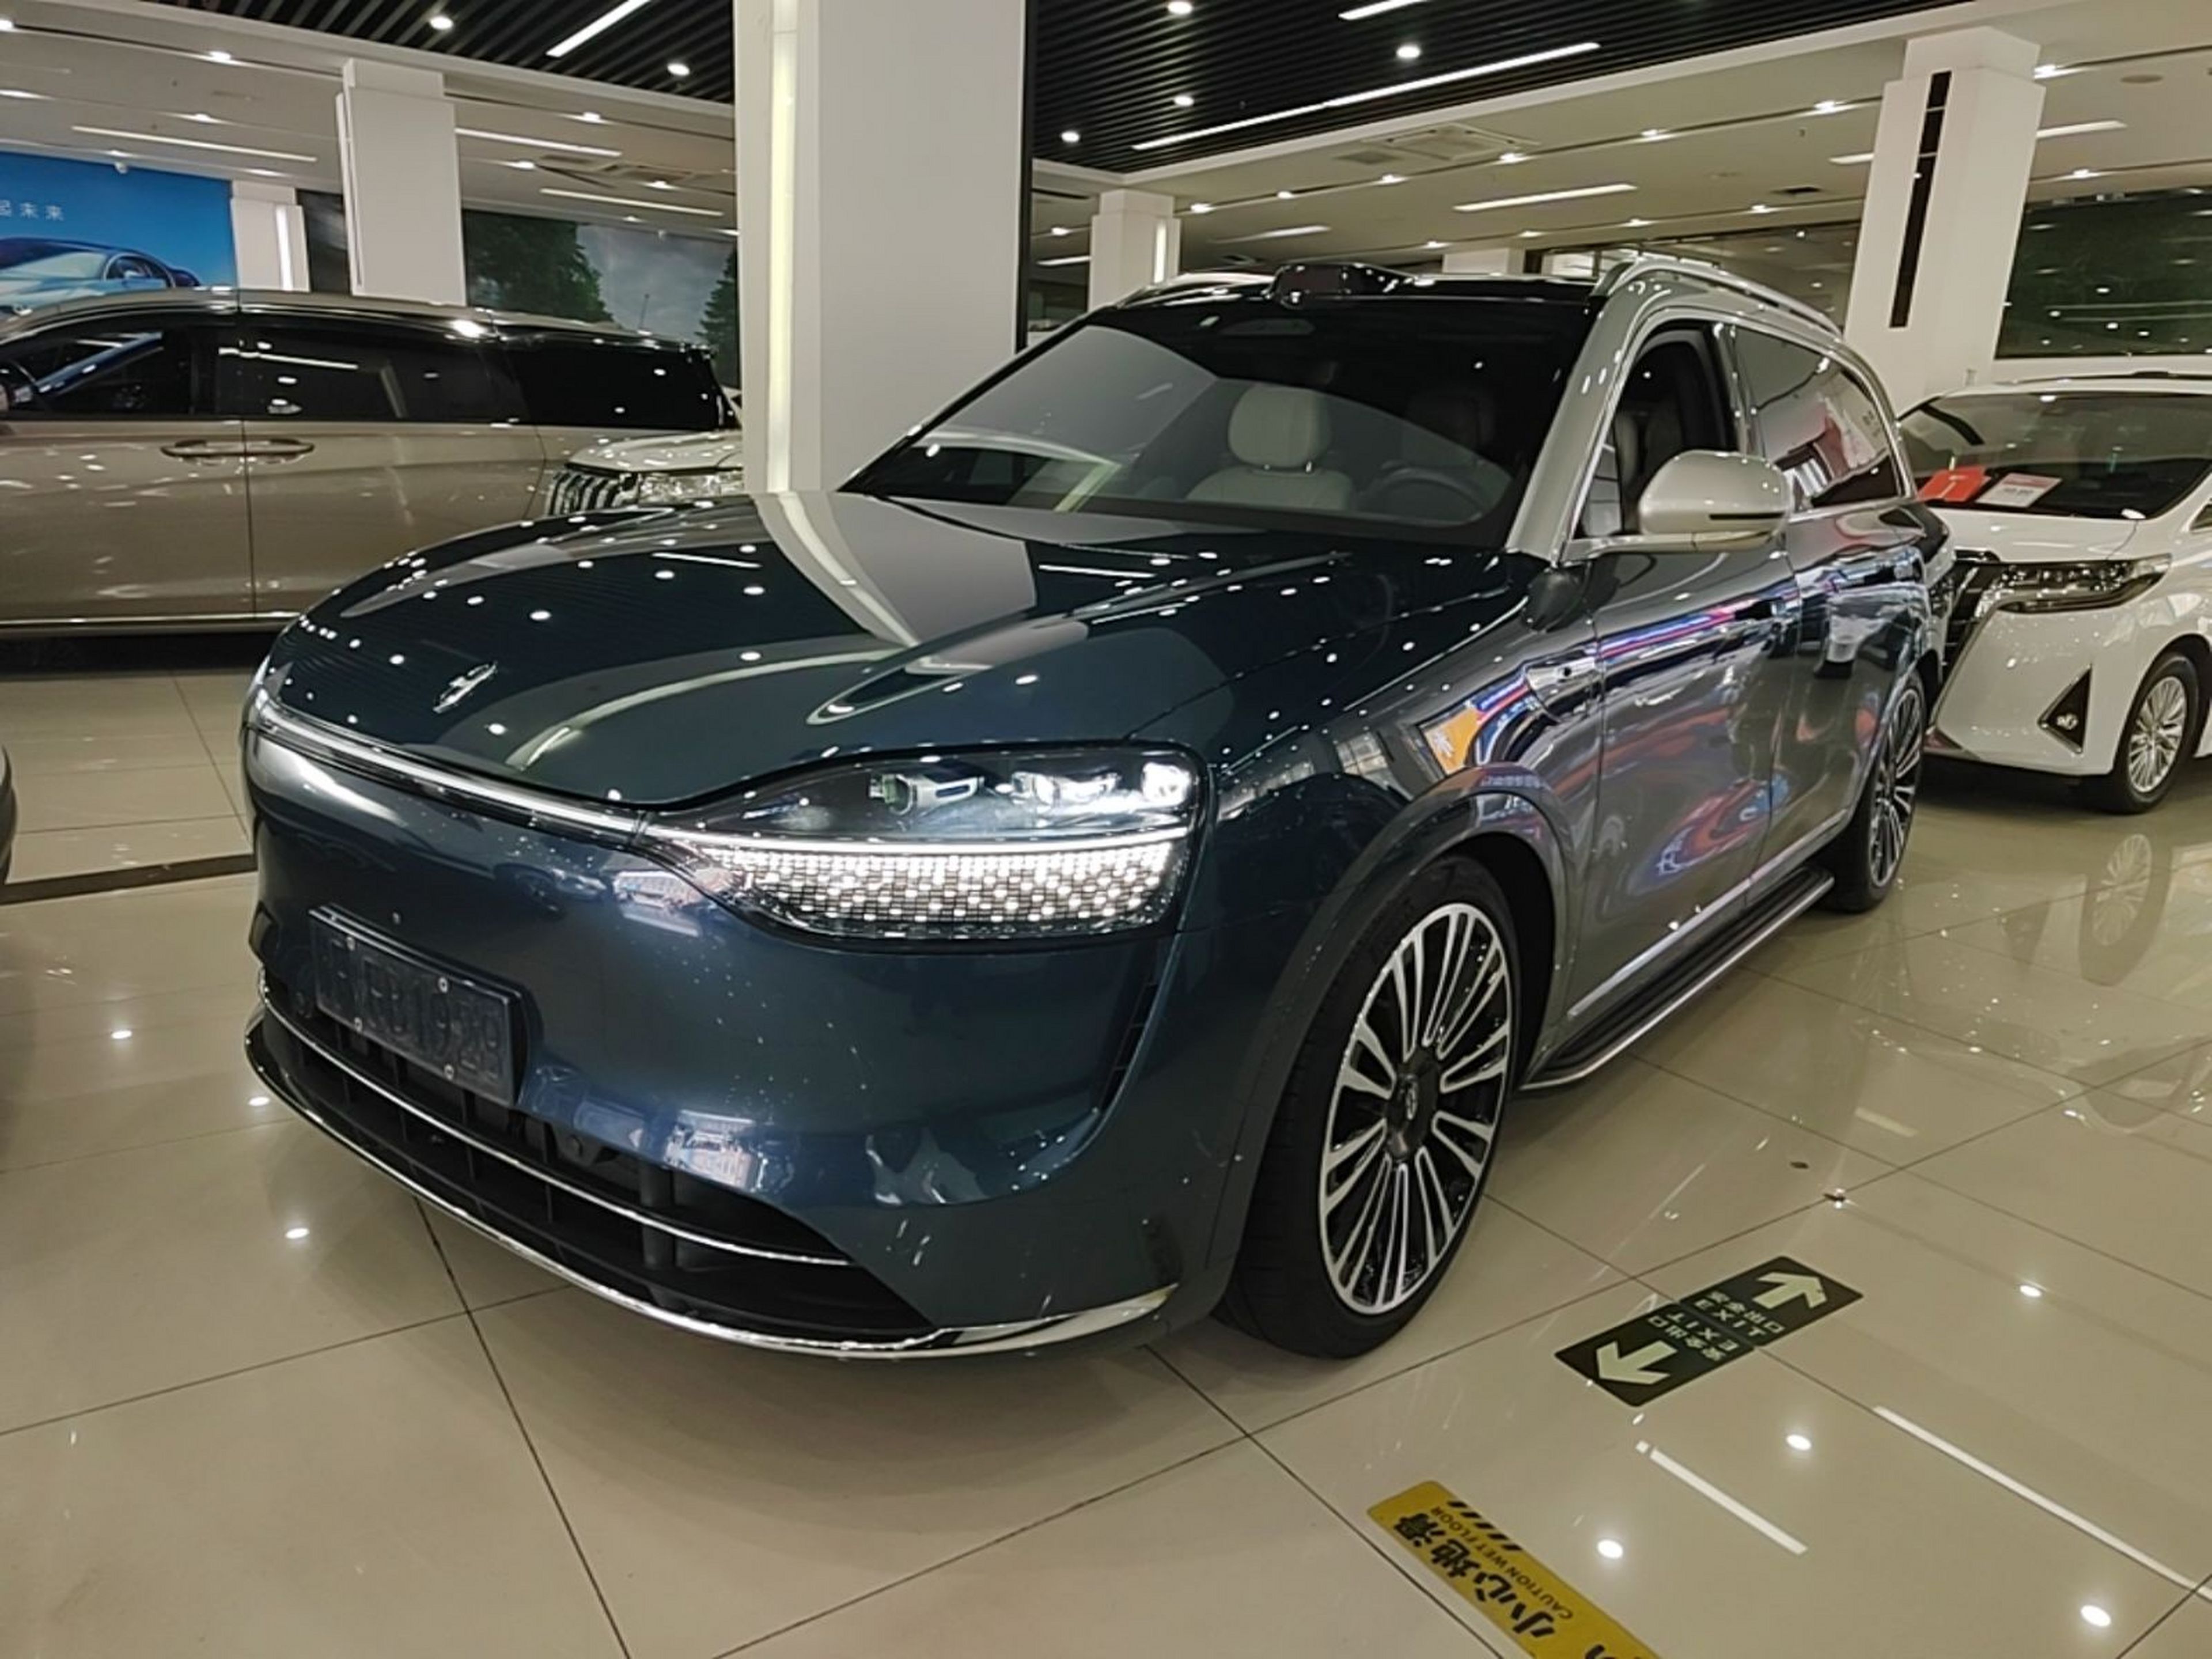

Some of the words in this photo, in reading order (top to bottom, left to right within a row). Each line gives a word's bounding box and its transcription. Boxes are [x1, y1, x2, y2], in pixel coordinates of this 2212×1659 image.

[1666, 1312, 1739, 1351] EXIT
[1695, 1298, 1766, 1336] EXIT
[1709, 1291, 1785, 1334] 安全出口
[1647, 1315, 1727, 1361] 安全出口
[1430, 1506, 1477, 1543] FLOOR
[1394, 1513, 1555, 1638] 小心地滑
[1476, 1543, 1508, 1568] WET
[1506, 1566, 1573, 1620] CAUTION
